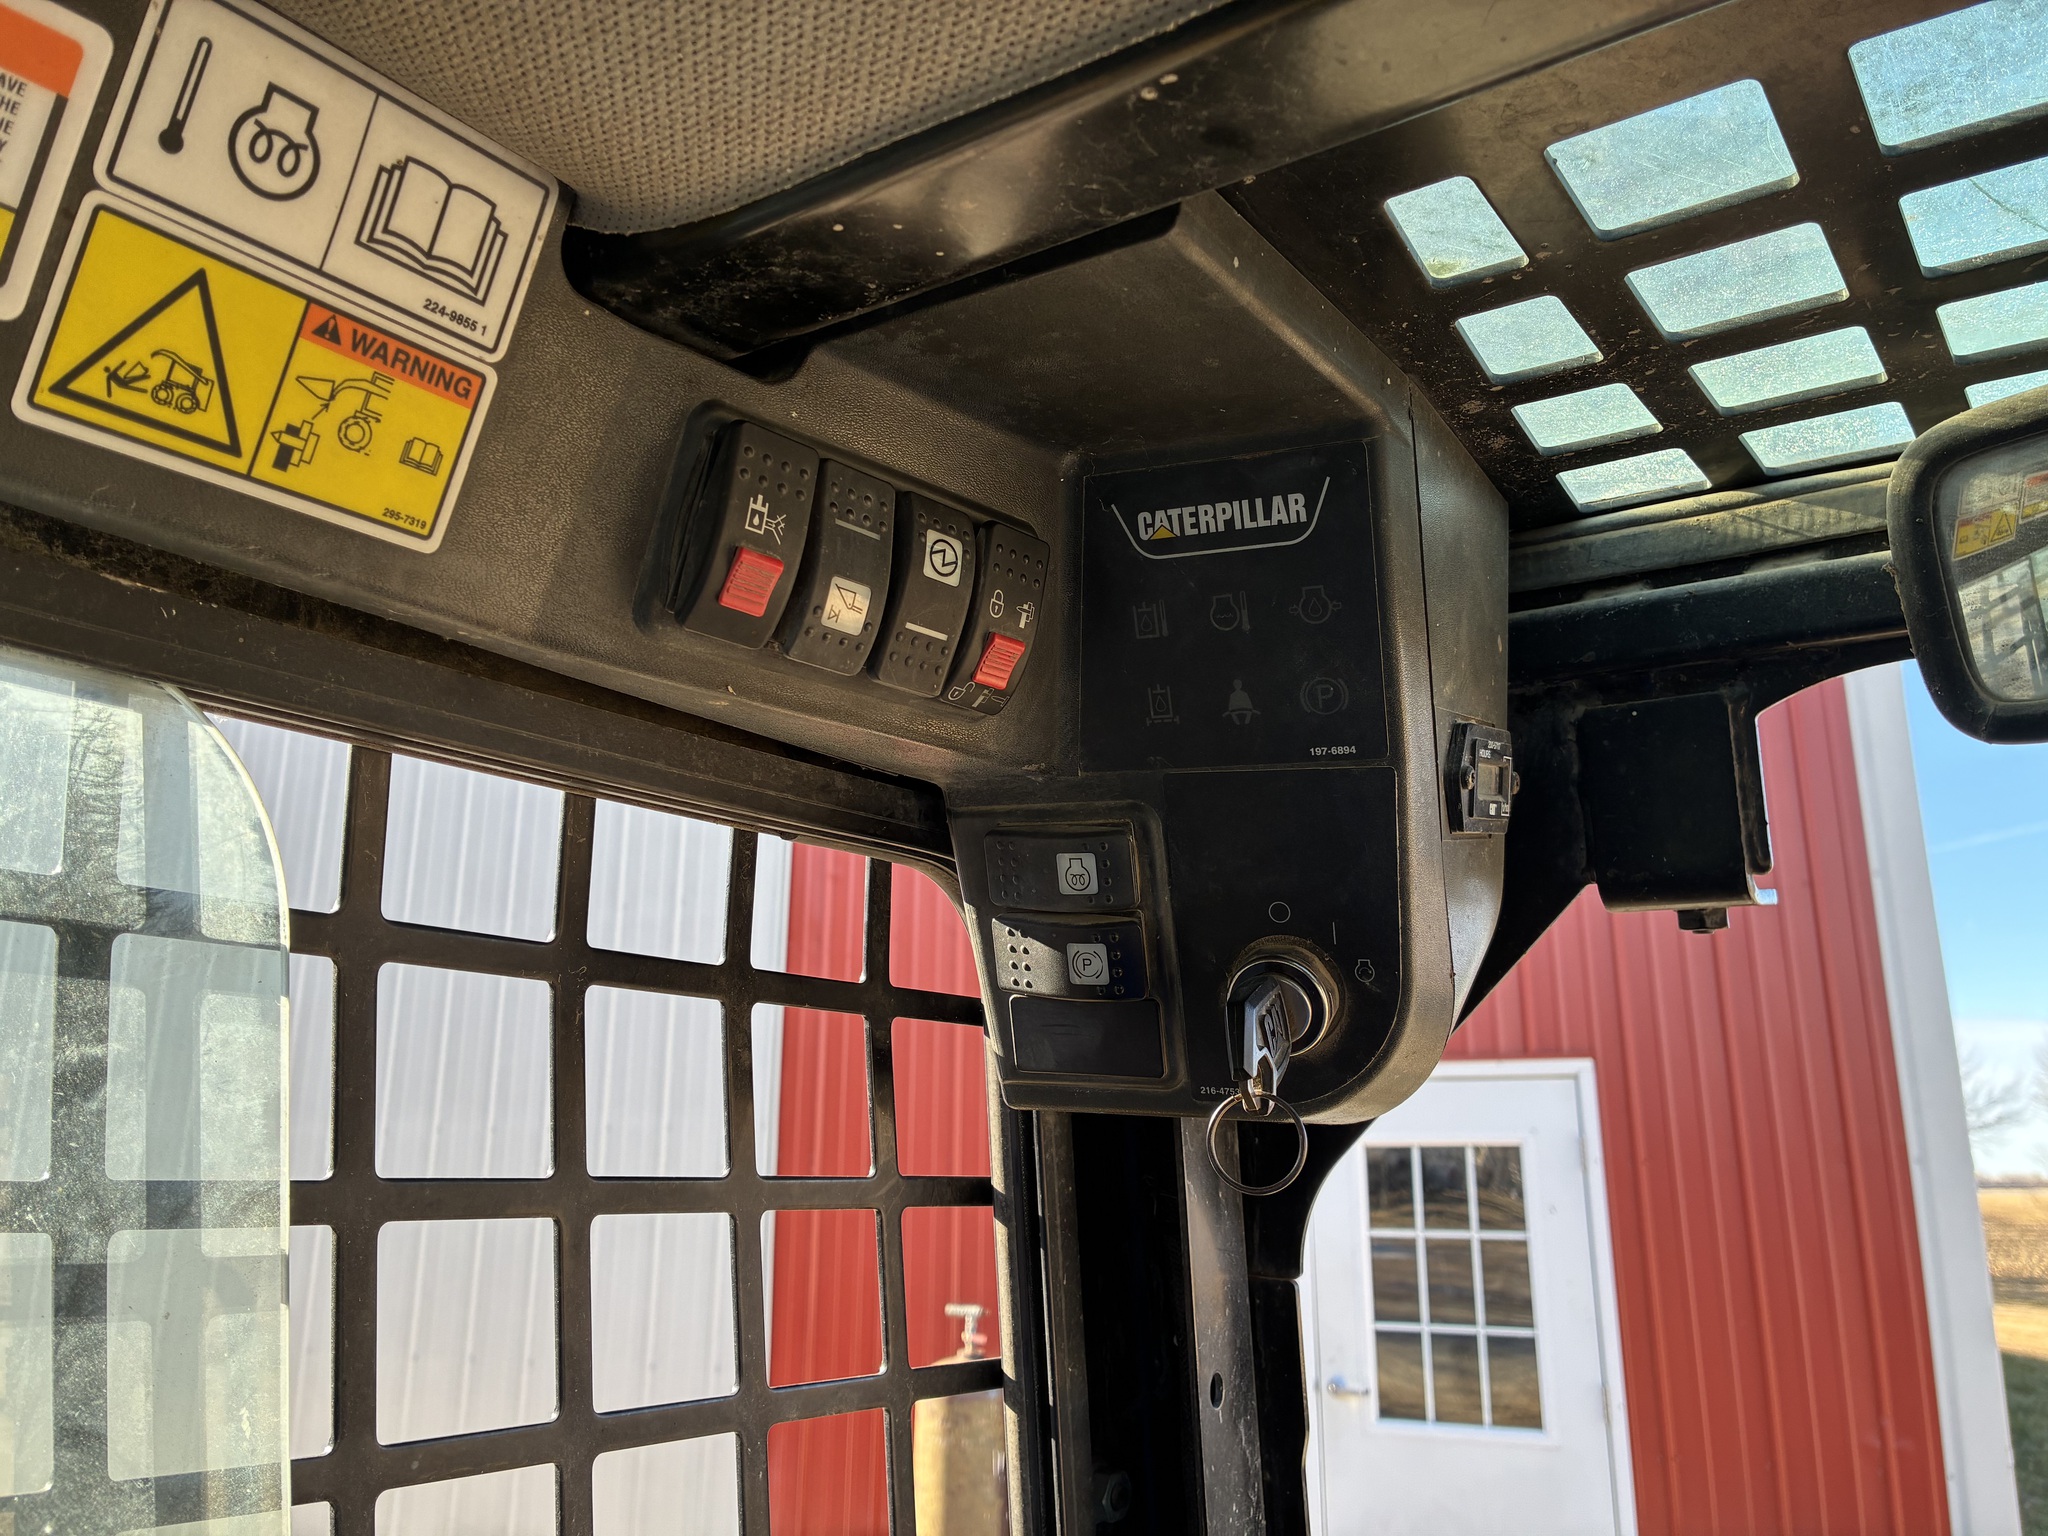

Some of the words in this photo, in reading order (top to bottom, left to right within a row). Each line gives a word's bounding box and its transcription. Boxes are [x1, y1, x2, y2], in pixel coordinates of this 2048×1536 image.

[422, 298, 478, 332] 224-9855
[351, 328, 473, 400] WARNING
[382, 507, 427, 529] 295-7319
[1137, 492, 1307, 541] CATERPILLAR
[1309, 745, 1357, 756] 197-6894
[1200, 1086, 1240, 1096] 216-4753
